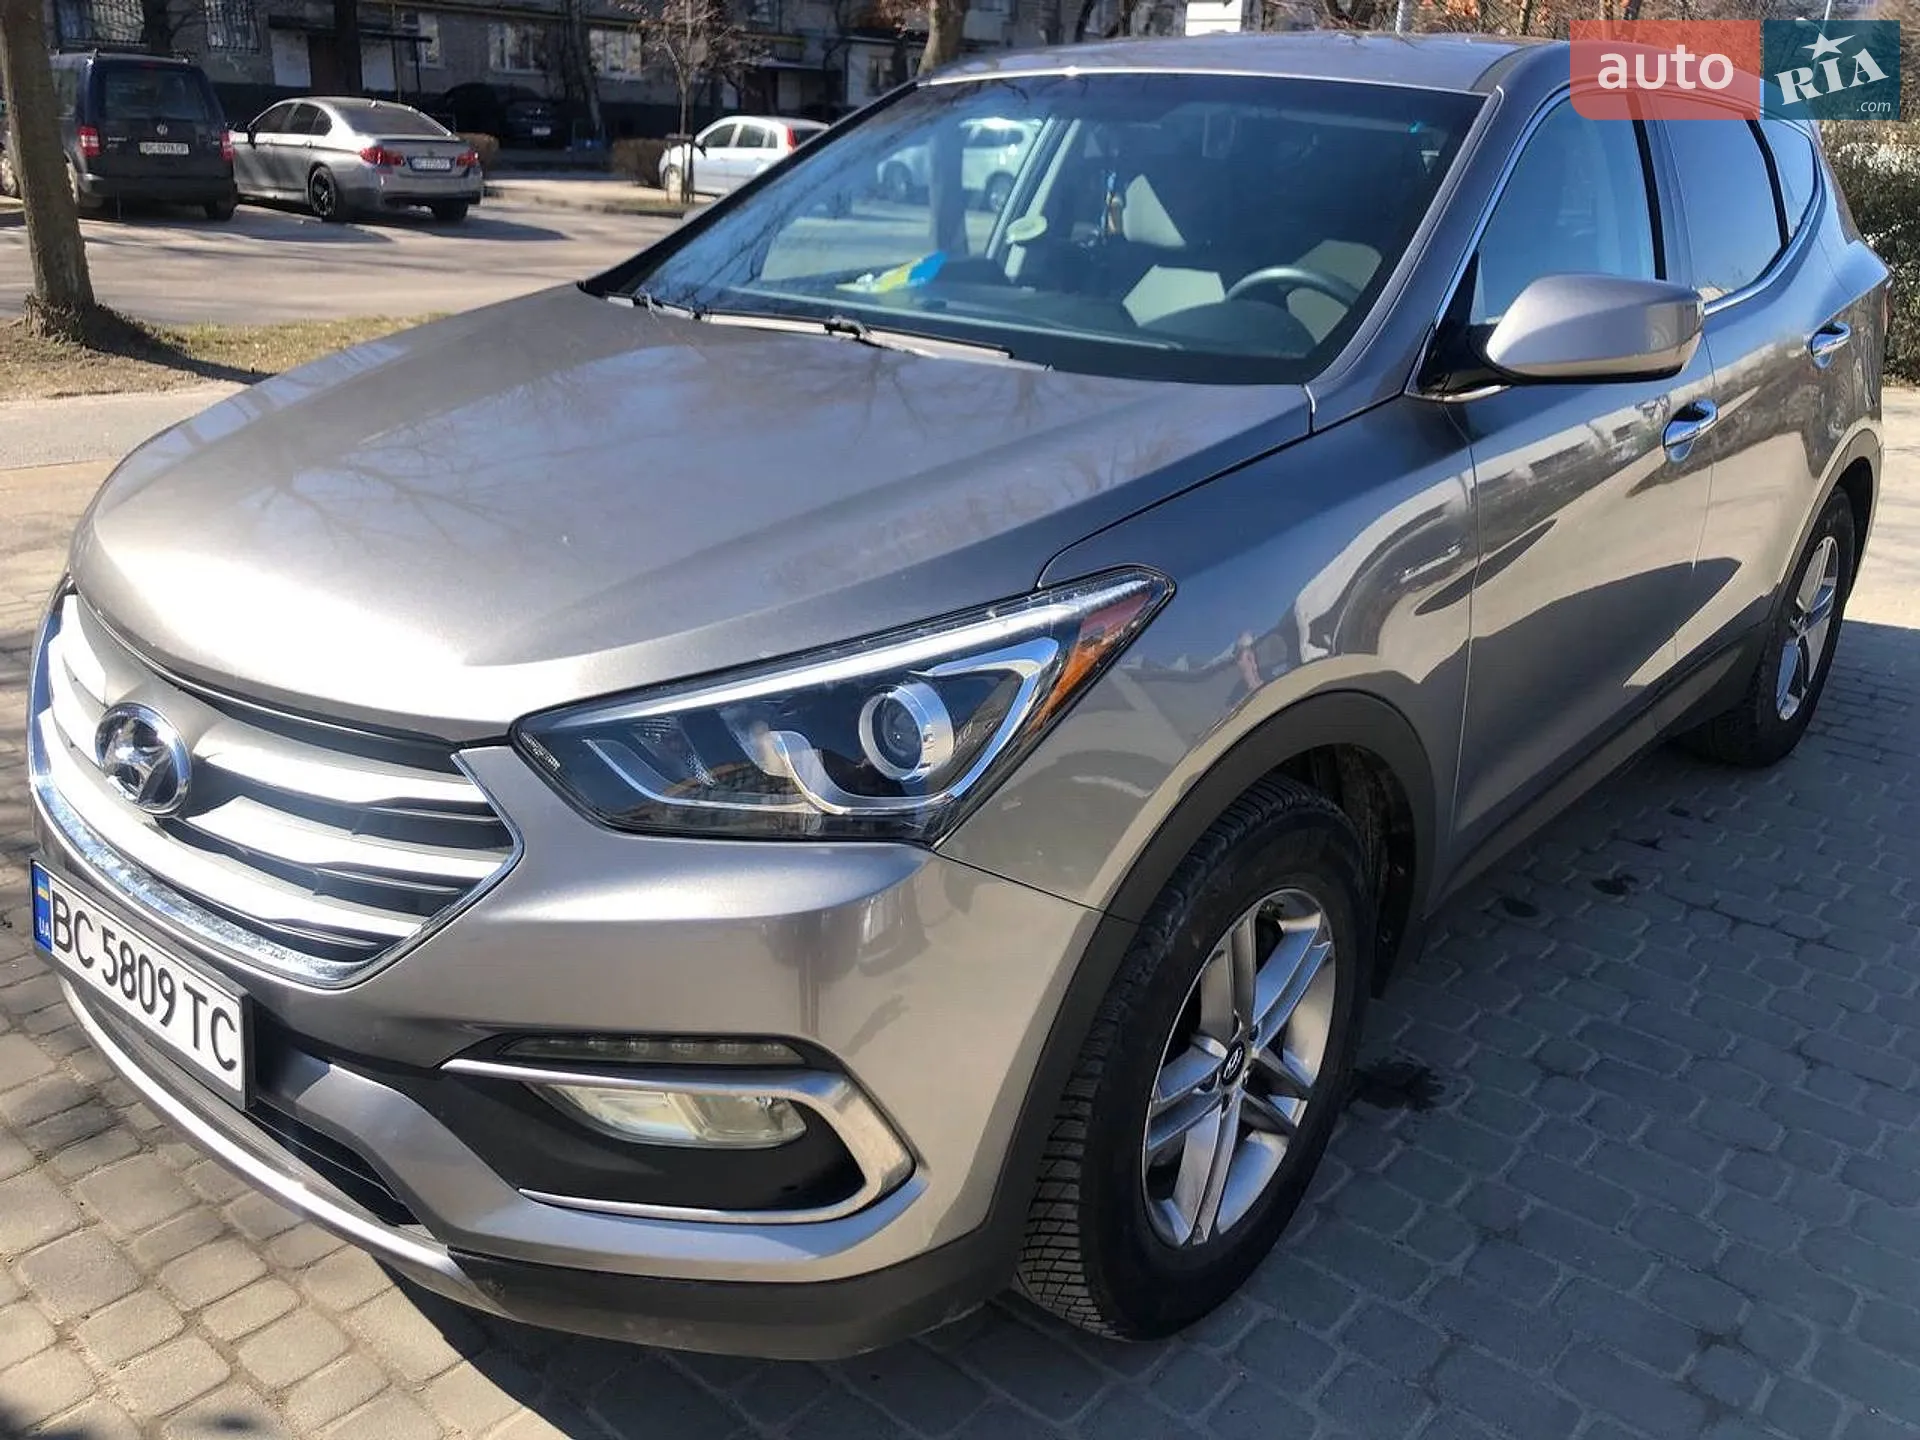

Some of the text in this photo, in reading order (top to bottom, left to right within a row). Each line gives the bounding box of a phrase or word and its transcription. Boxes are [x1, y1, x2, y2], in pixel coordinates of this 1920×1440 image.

[38, 916, 51, 940] UA
[52, 890, 237, 1071] BC 5809 TC
